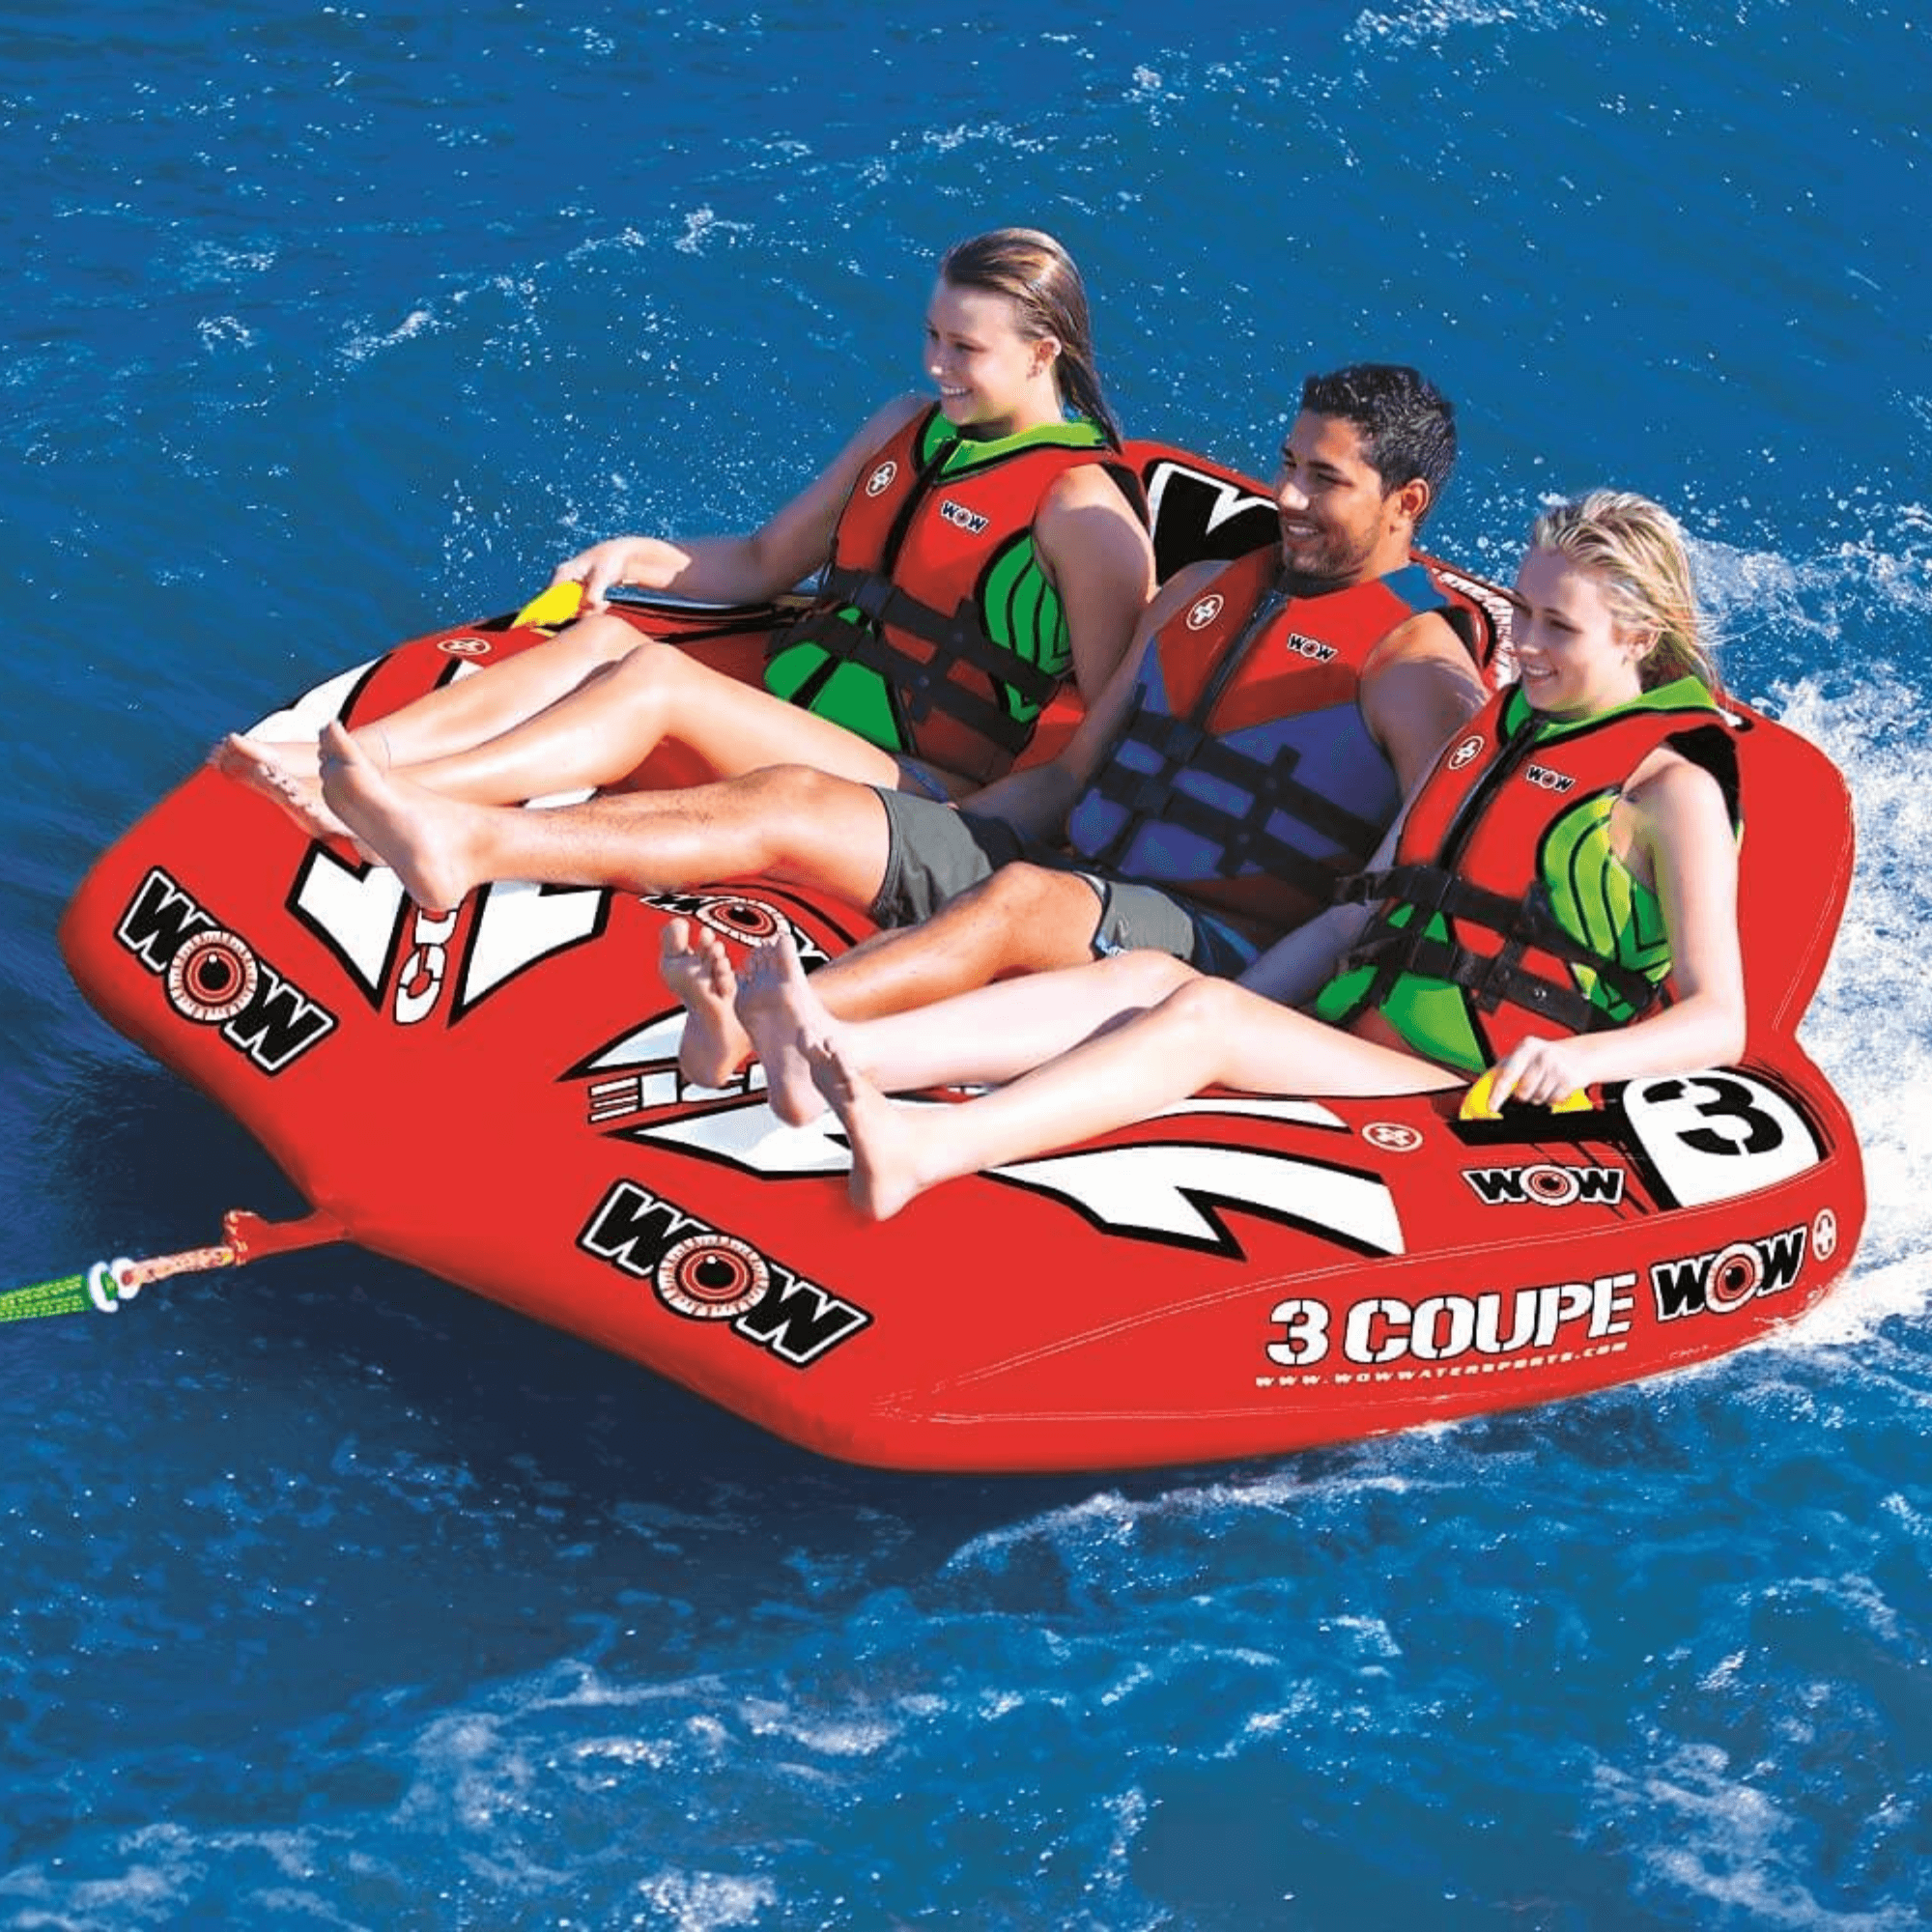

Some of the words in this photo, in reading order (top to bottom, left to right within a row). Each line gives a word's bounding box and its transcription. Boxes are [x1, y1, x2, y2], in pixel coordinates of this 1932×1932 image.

[941, 499, 988, 533] WOW
[1287, 633, 1338, 664] WOW
[1526, 764, 1576, 793] WOW
[115, 867, 338, 1075] WOW
[1642, 1076, 1784, 1156] 3
[1462, 1164, 1625, 1207] WOW
[577, 1179, 873, 1368] WOW
[1650, 1225, 1808, 1322] WOW
[1266, 1298, 1330, 1366] 3
[1344, 1272, 1637, 1364] COUPE
